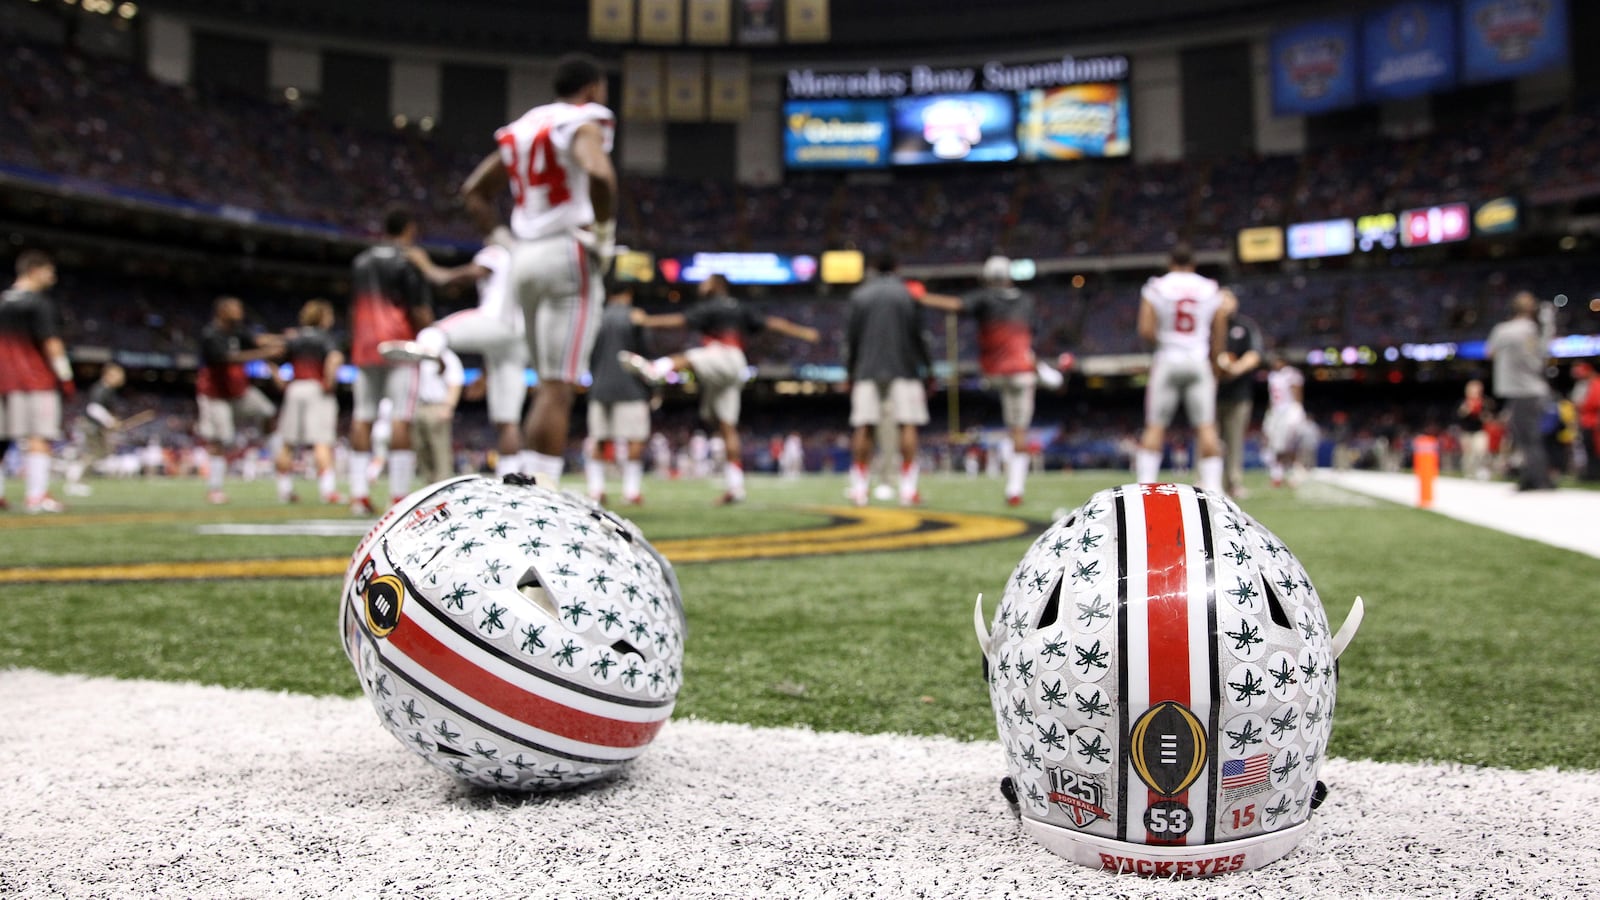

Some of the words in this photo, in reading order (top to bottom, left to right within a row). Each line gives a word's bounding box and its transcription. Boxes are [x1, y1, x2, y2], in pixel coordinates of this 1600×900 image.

[983, 56, 1128, 90] Superdome
[1174, 298, 1197, 333] 6
[1054, 766, 1096, 805] 125
[1057, 794, 1096, 812] FOOTBALL
[1231, 803, 1256, 830] 15
[1150, 808, 1187, 833] 53
[1099, 852, 1247, 877] BUCKEYES
